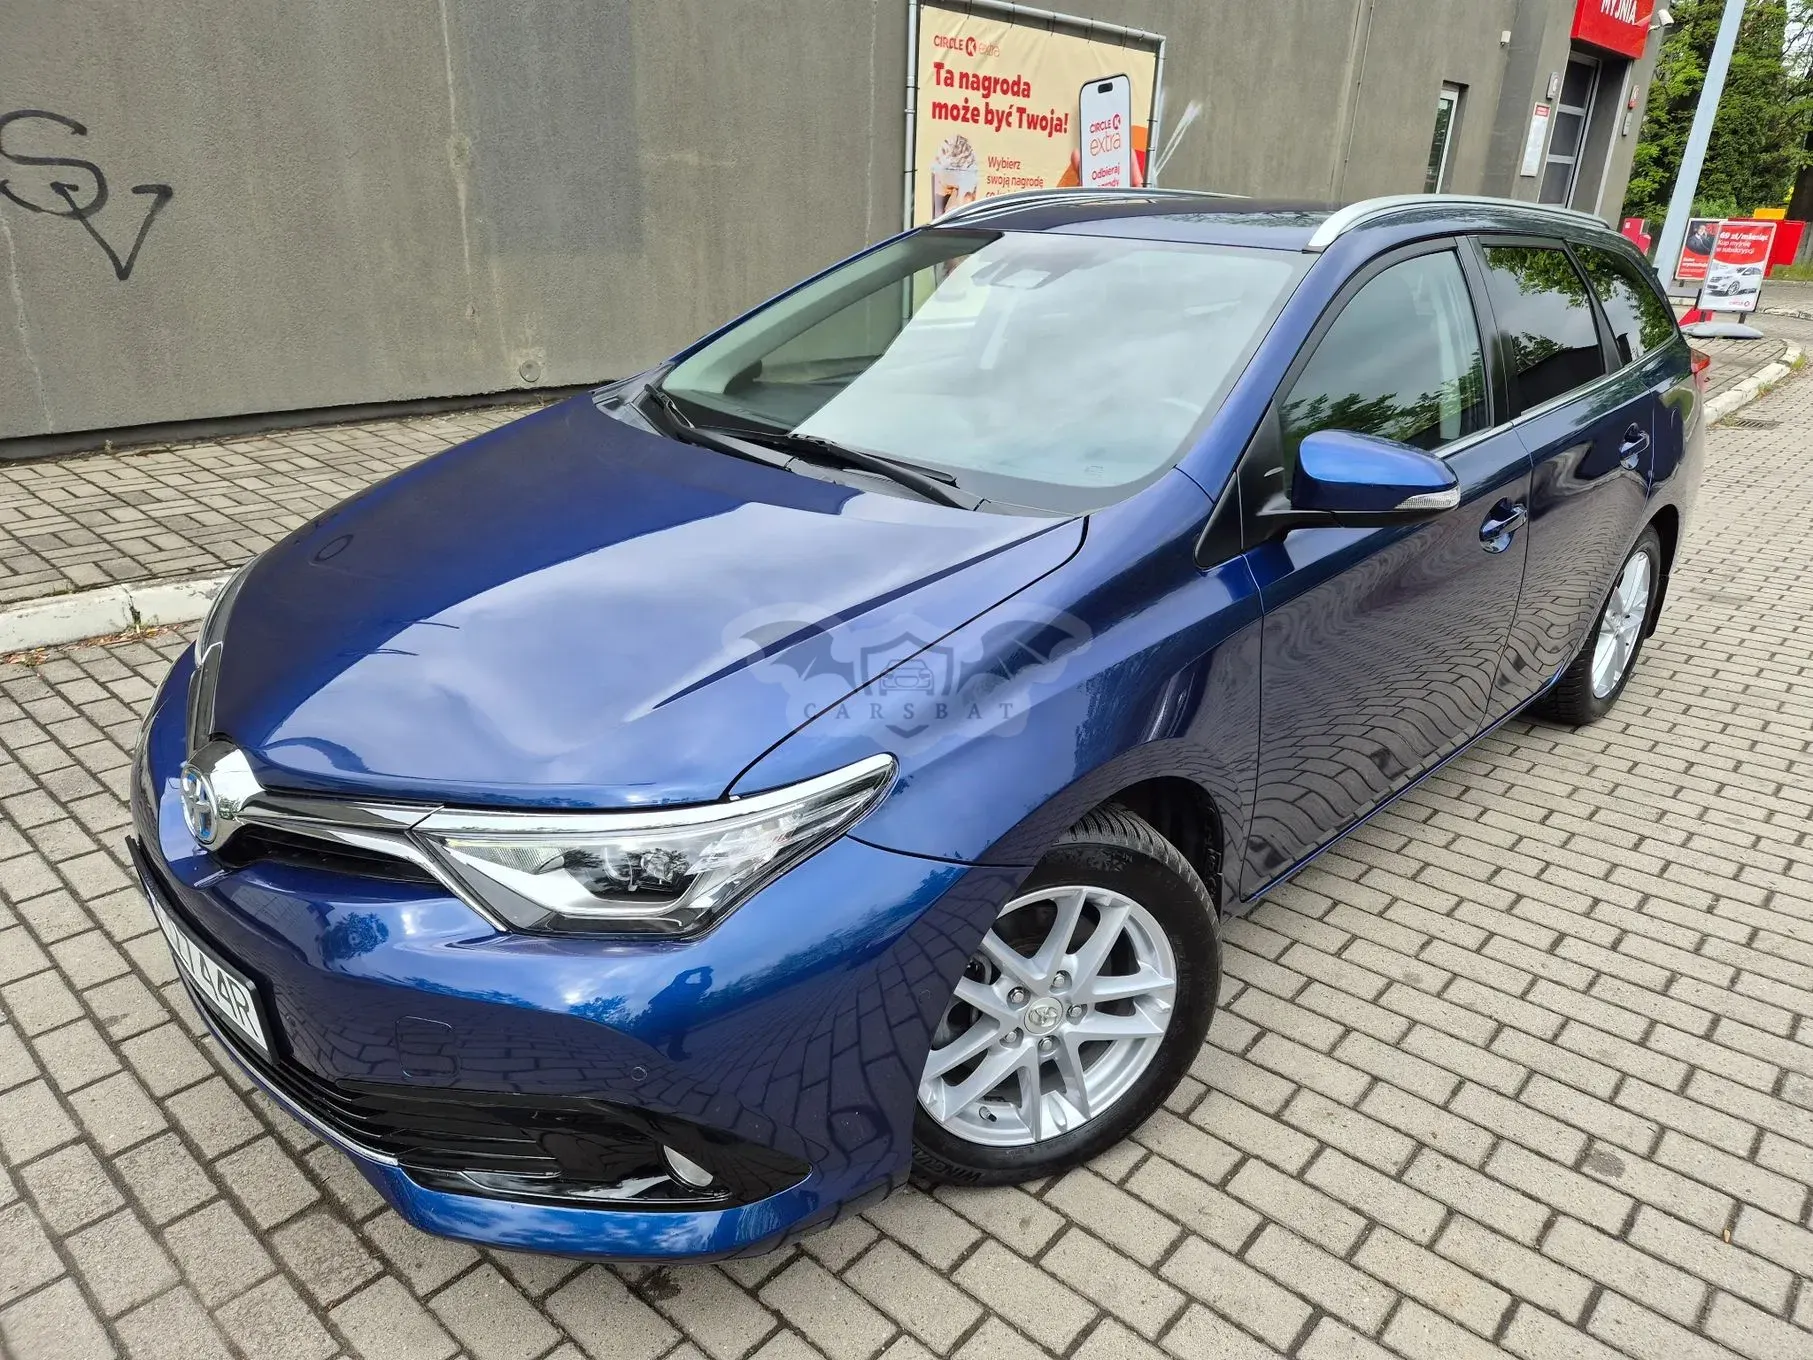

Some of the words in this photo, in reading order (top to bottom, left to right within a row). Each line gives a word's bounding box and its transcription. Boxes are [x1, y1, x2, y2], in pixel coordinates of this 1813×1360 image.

[933, 35, 964, 51] CIRCLE
[965, 36, 977, 57] K
[933, 61, 955, 88] Ta
[958, 71, 1031, 99] nagroda
[931, 97, 981, 125] może
[984, 101, 1014, 132] być
[1016, 106, 1069, 138] Twoja!
[1089, 119, 1111, 134] CIRCLE
[1112, 113, 1121, 130] K
[1089, 130, 1121, 157] extra
[987, 155, 1021, 172] Wybierz
[1091, 161, 1120, 181] Odbieraj
[986, 173, 1010, 189] swoją
[1011, 175, 1044, 190] nagrodę
